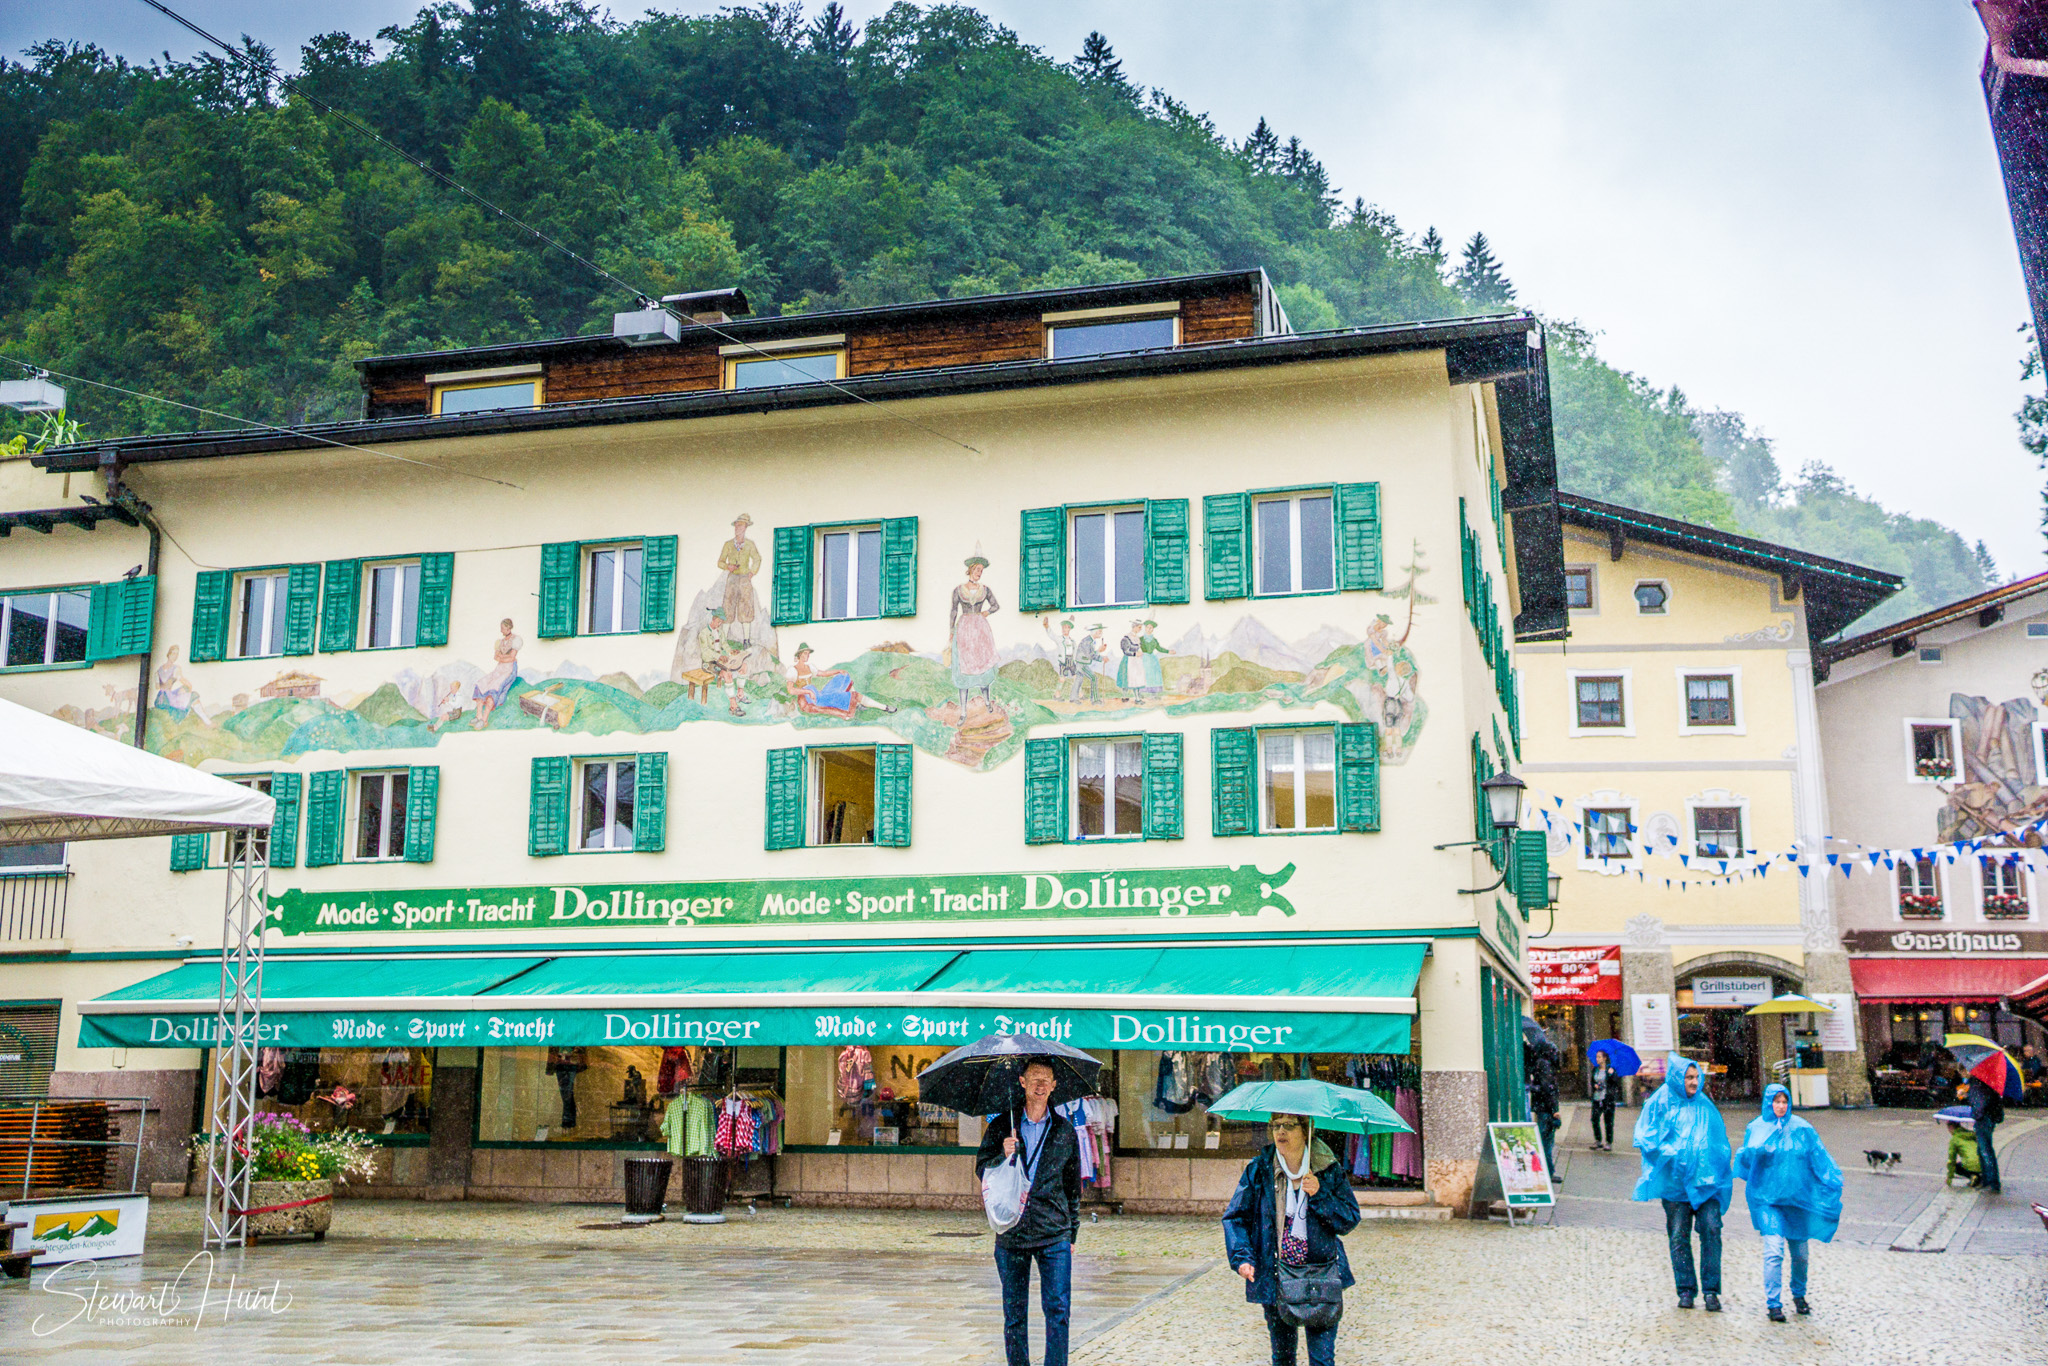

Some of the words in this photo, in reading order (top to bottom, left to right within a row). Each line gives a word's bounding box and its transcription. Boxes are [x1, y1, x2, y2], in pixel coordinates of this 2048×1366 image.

[316, 900, 380, 925] Mode
[392, 900, 454, 929] Sport
[467, 898, 536, 922] Tracht
[549, 887, 734, 927] Dollinger
[760, 891, 831, 916] Mode
[846, 888, 916, 920] Sport
[930, 886, 1010, 912] Tracht
[1020, 874, 1232, 917] Dollinger
[1891, 930, 2022, 953] Gasthaus
[1544, 976, 1567, 984] uns
[1570, 974, 1598, 984] aus!
[1699, 980, 1766, 991] Grillstüberl
[331, 1018, 386, 1040] Mode
[408, 1017, 466, 1044] Sport
[487, 1016, 555, 1043] Tracht
[603, 1013, 761, 1046] Dollinger
[814, 1015, 877, 1038] Mode
[902, 1014, 969, 1043] Sport
[993, 1015, 1073, 1042] Tracht
[1110, 1014, 1293, 1052] Dollinger
[380, 1065, 431, 1086] SALE
